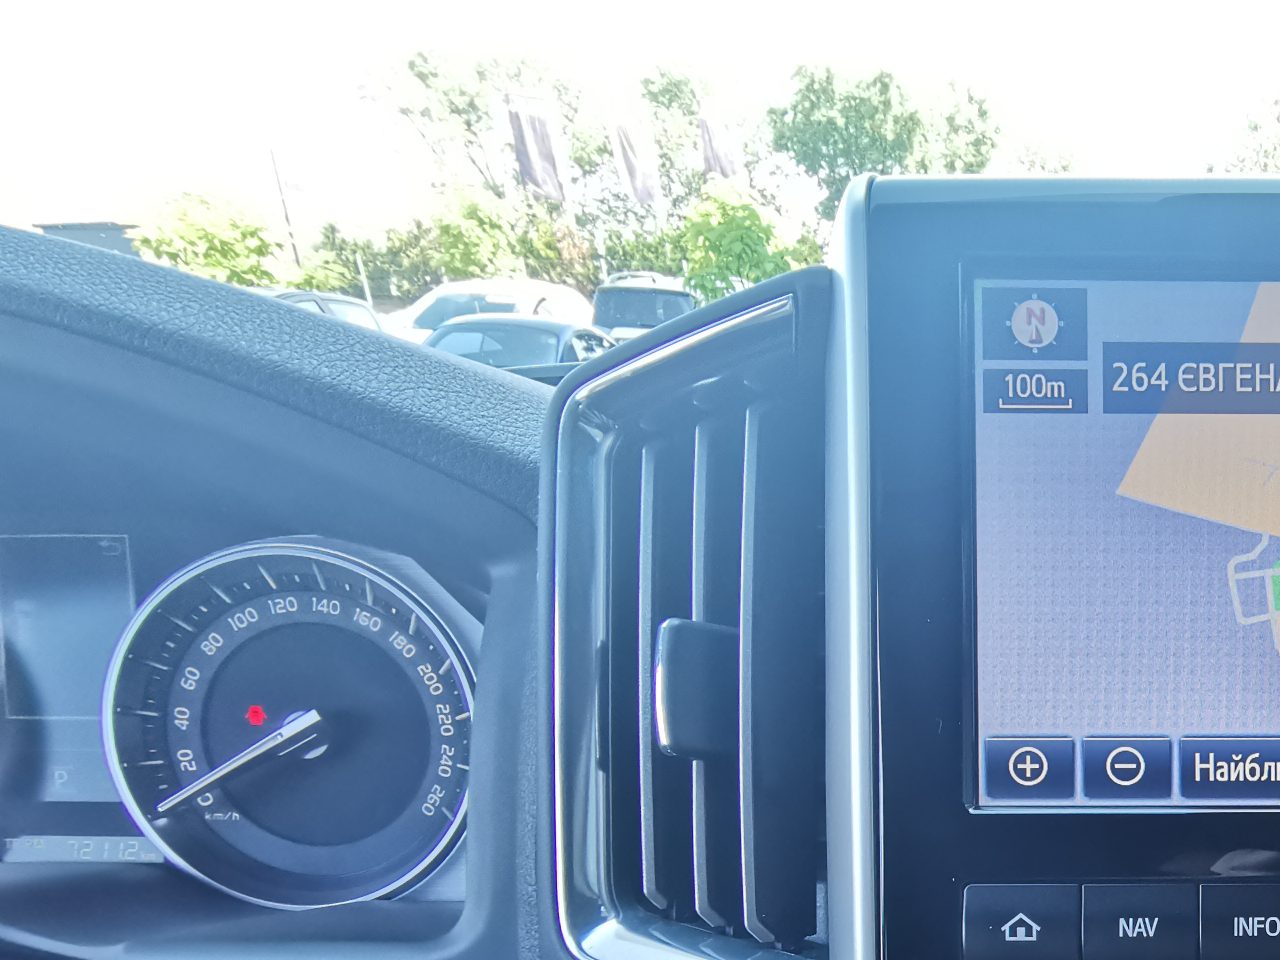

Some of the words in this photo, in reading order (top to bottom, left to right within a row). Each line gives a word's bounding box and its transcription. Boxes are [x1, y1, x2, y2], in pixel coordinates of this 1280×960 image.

[1005, 373, 1065, 399] 100m
[1112, 362, 1169, 392] 264
[268, 597, 298, 615] 120
[312, 597, 340, 615] 140
[228, 608, 259, 631] 100
[353, 608, 382, 632] 160
[201, 633, 224, 655] 80
[389, 631, 416, 658] 180
[181, 667, 200, 690] 60
[417, 663, 443, 695] 200
[174, 707, 190, 730] 40
[436, 704, 454, 736] 220
[177, 749, 197, 771] 20
[438, 745, 455, 777] 240
[422, 784, 446, 816] 260
[205, 812, 240, 821] km/h
[1118, 917, 1159, 938] NAV
[1233, 916, 1280, 938] INFO
